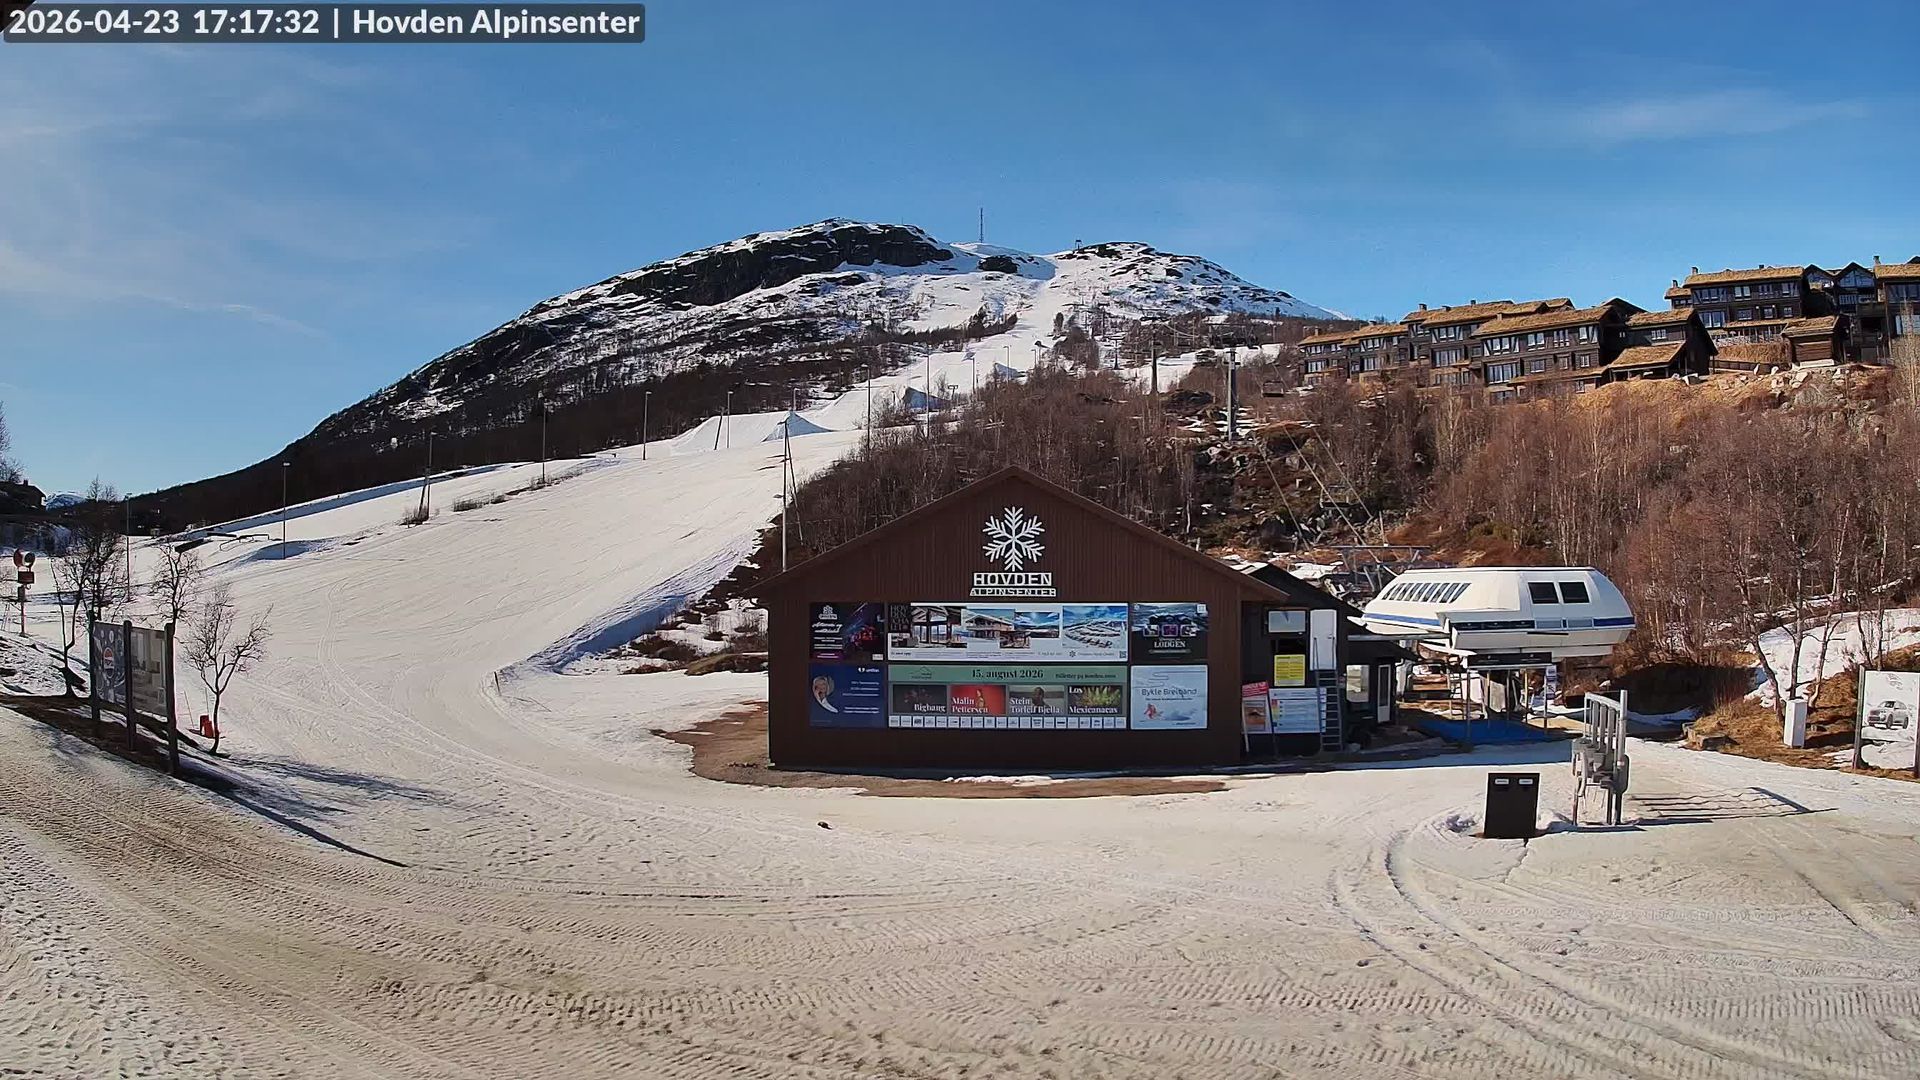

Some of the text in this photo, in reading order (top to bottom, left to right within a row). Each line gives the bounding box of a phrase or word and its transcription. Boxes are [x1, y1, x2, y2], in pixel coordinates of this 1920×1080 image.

[973, 572, 1052, 587] HOVDEN
[969, 587, 1057, 597] ALPINSENTER
[1153, 641, 1187, 649] LODGEN
[972, 669, 1044, 680] 15. august 2026
[1068, 686, 1083, 694] Los
[1141, 688, 1162, 697] Bykle
[952, 697, 975, 705] Malin
[1009, 697, 1030, 705] Stein
[914, 703, 946, 713] Bigbang
[952, 705, 989, 713] Pettersen
